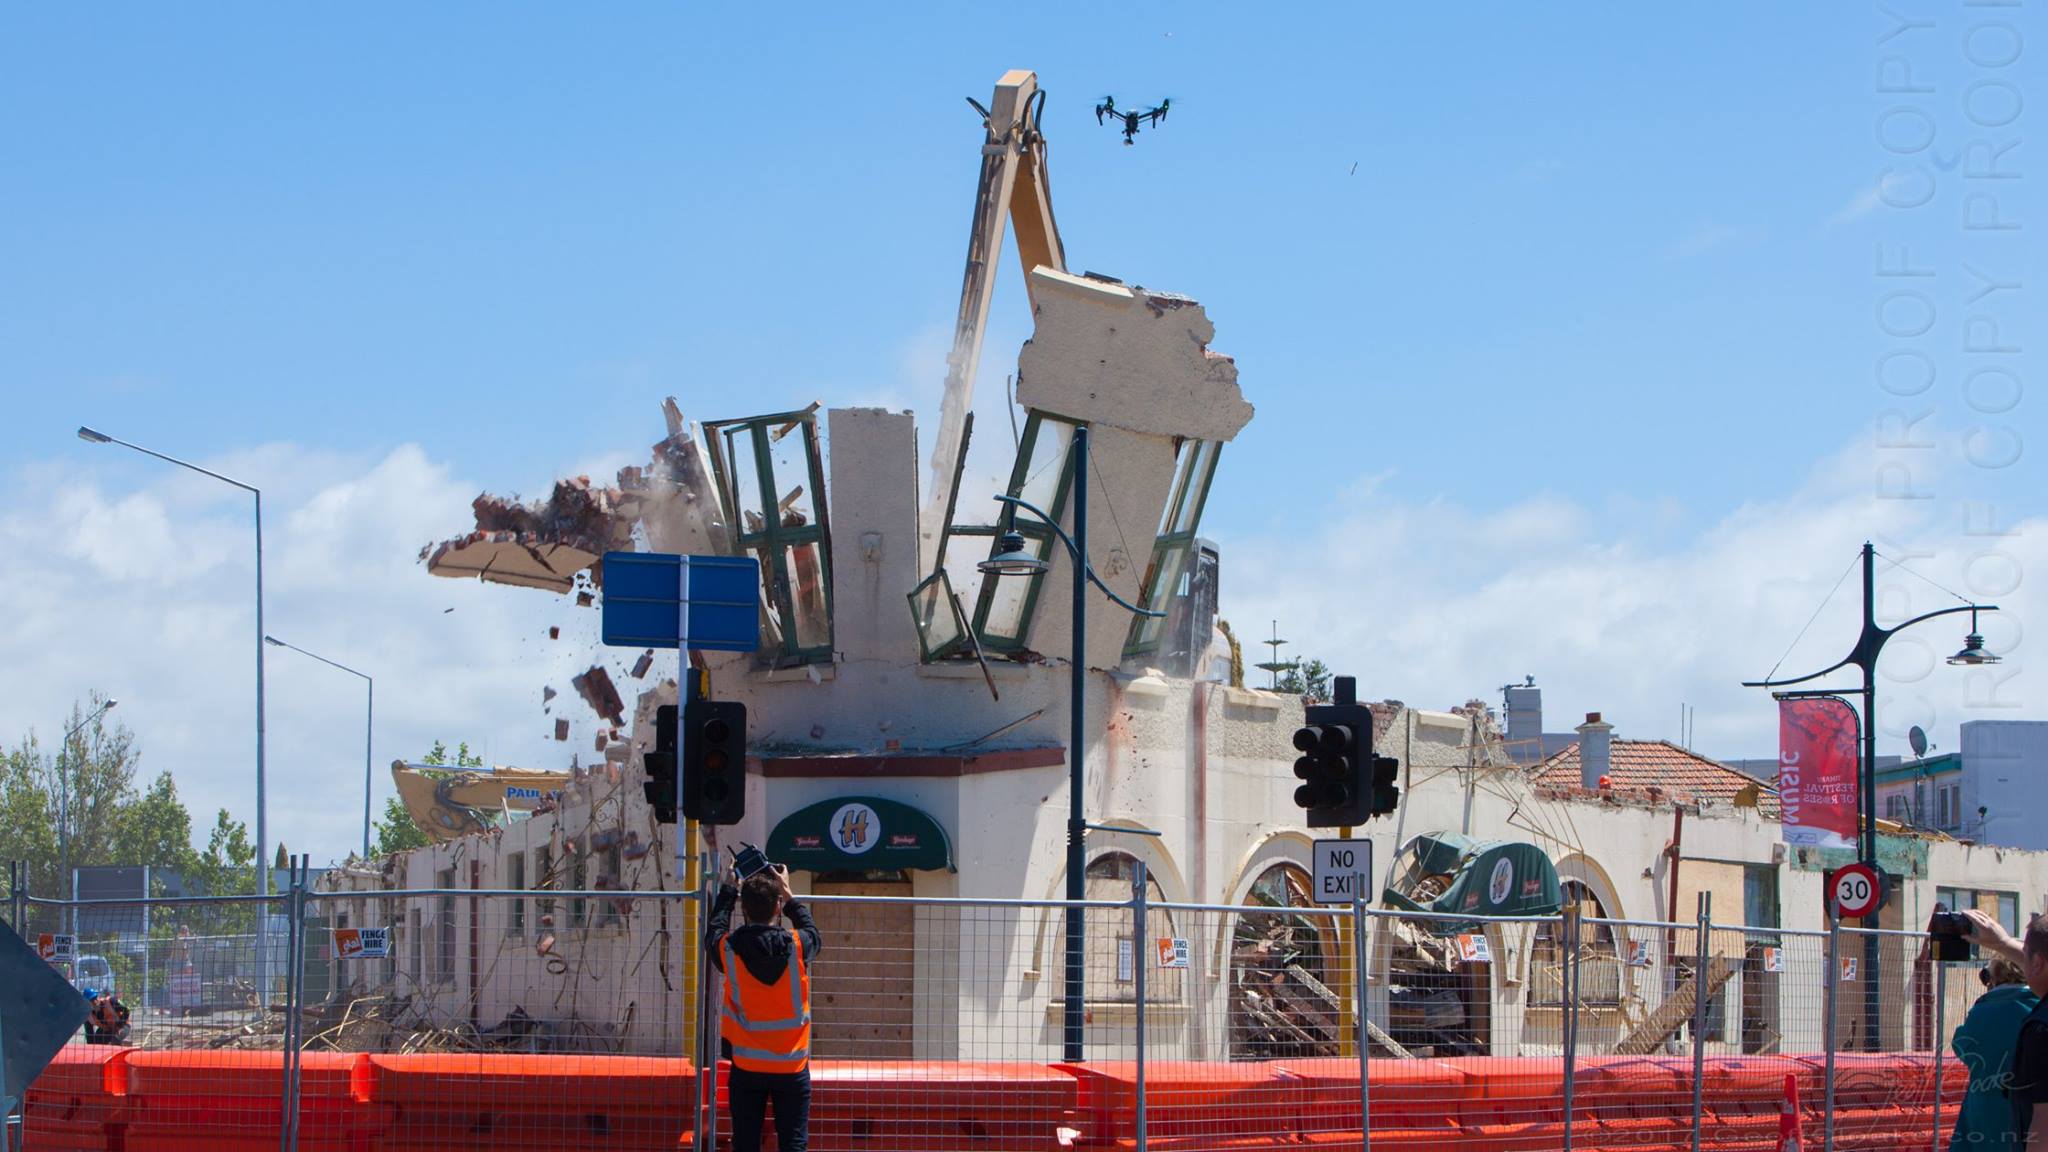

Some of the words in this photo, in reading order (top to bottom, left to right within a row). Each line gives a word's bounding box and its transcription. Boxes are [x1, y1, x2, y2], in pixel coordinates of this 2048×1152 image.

[1330, 850, 1355, 868] NO
[1841, 880, 1869, 901] 30
[361, 930, 386, 939] FENCE
[364, 940, 384, 949] HIRE
